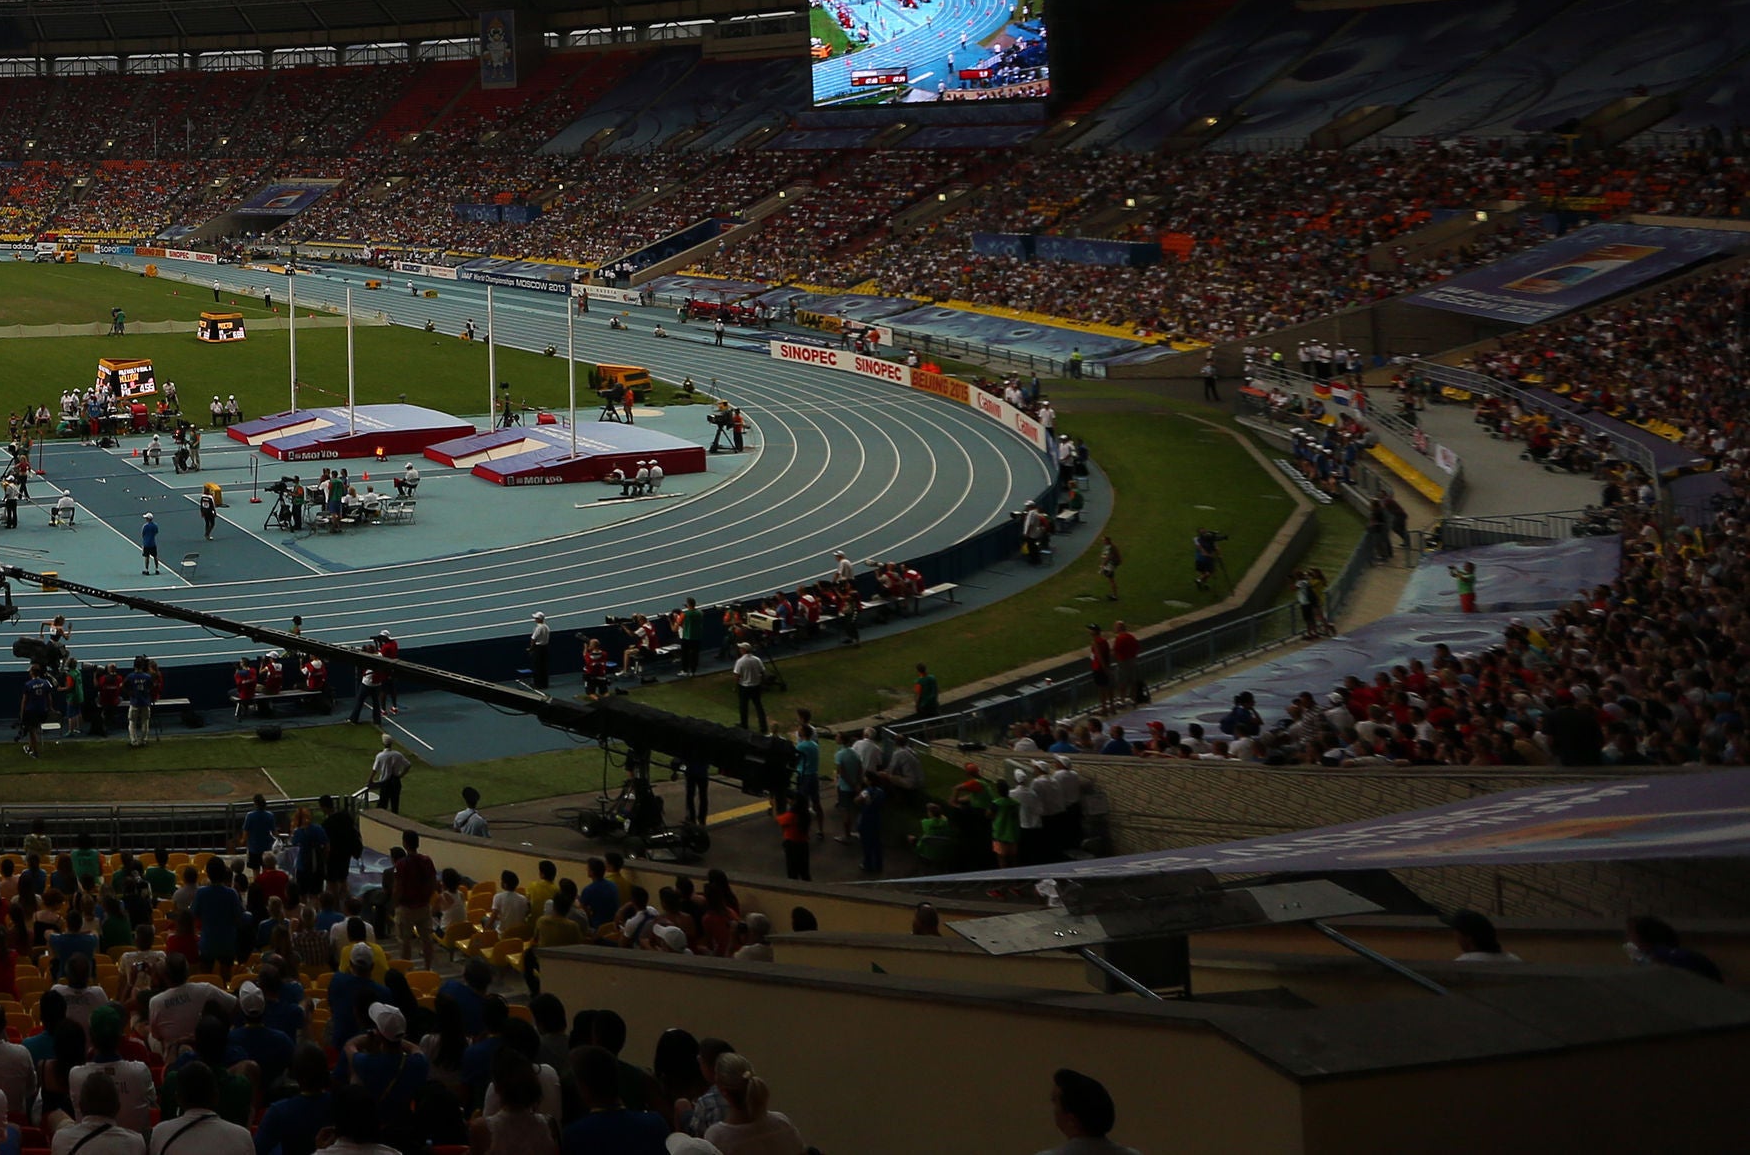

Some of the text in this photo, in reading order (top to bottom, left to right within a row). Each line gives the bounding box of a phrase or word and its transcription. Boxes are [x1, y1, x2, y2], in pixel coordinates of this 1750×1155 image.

[100, 245, 117, 254] SOPOT
[169, 250, 189, 259] SINOPEC
[196, 253, 214, 262] SINOPEC
[486, 273, 515, 287] Championships
[515, 277, 548, 290] MOSCOW
[548, 281, 566, 293] 2013
[780, 344, 838, 366] SINOPEC
[854, 356, 902, 381] SINOPEC
[911, 371, 969, 402] BEIJING 2015
[977, 391, 1002, 419] Canon
[1015, 412, 1039, 443] Canon
